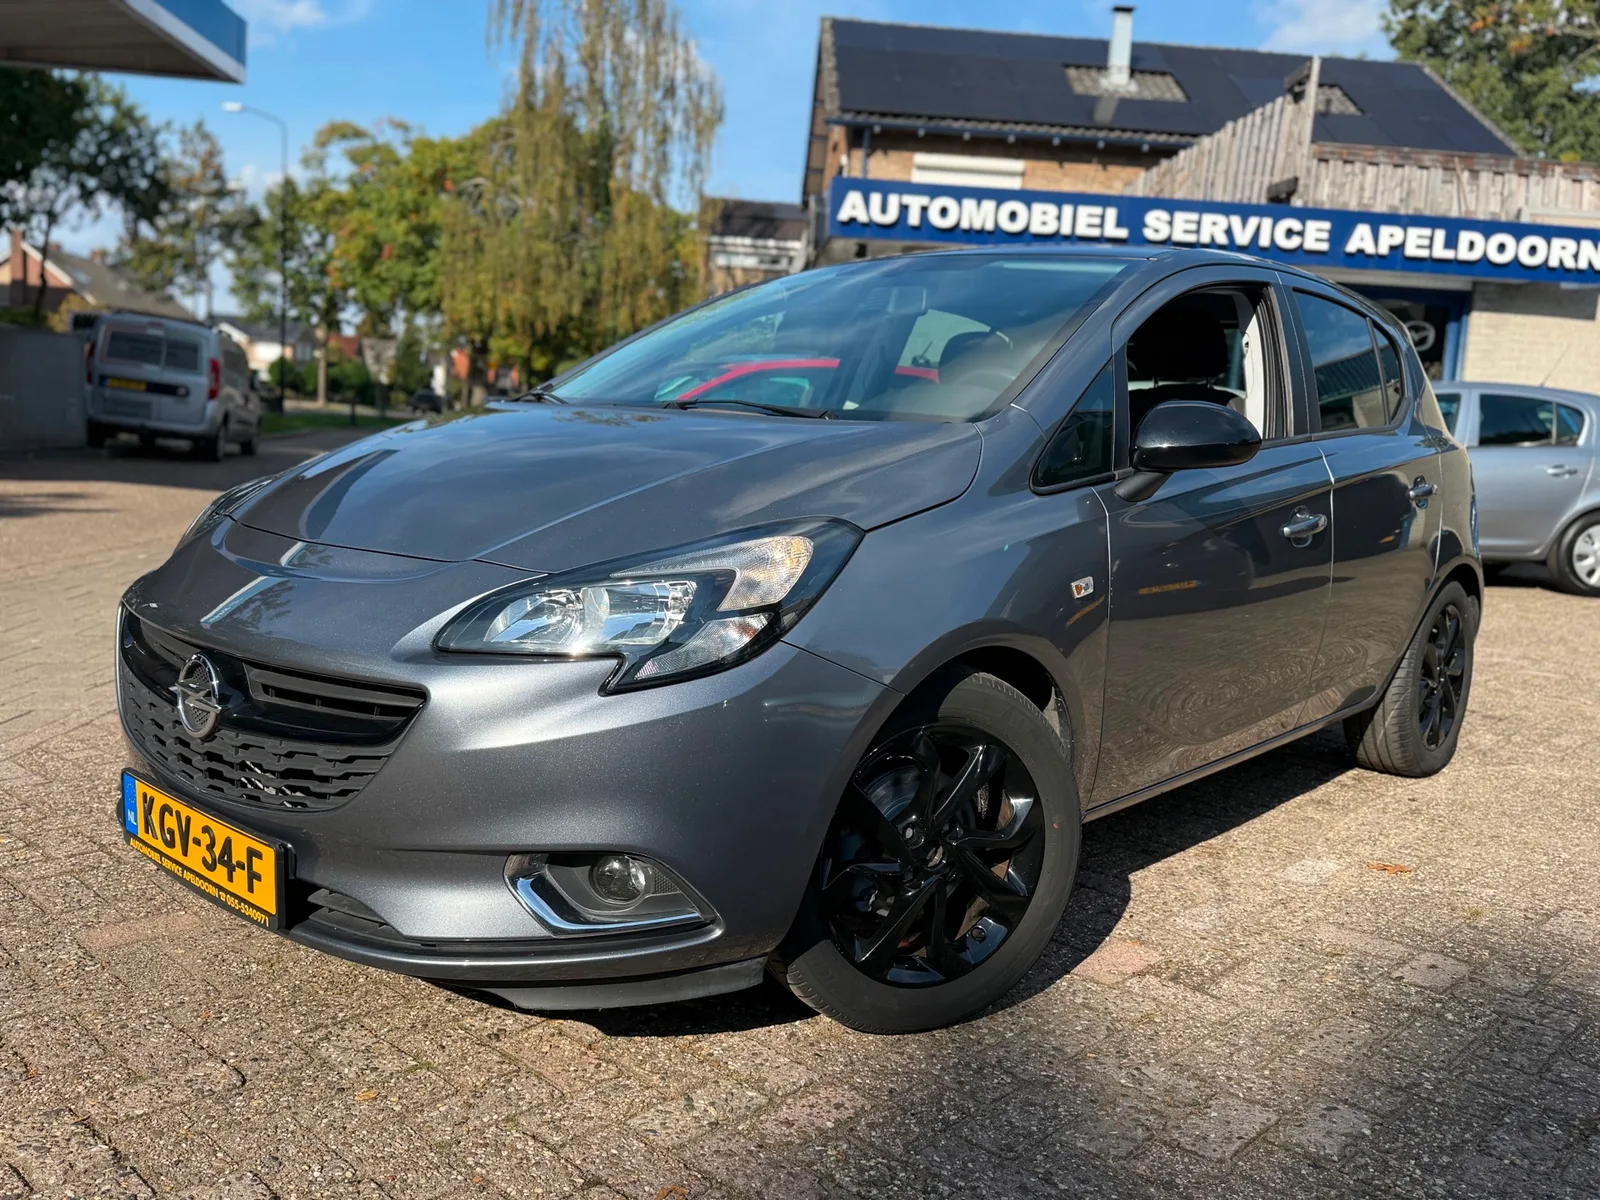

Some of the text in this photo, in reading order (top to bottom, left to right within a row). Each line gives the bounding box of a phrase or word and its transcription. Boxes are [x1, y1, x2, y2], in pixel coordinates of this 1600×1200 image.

[836, 190, 1600, 272] AUTOMOBIEL SERVICE APELDOORN
[127, 808, 137, 826] NL
[142, 791, 263, 895] KGV-34-F
[129, 837, 269, 927] AUTOMOBIEL SERVICE APELDOORN 055-5340971
